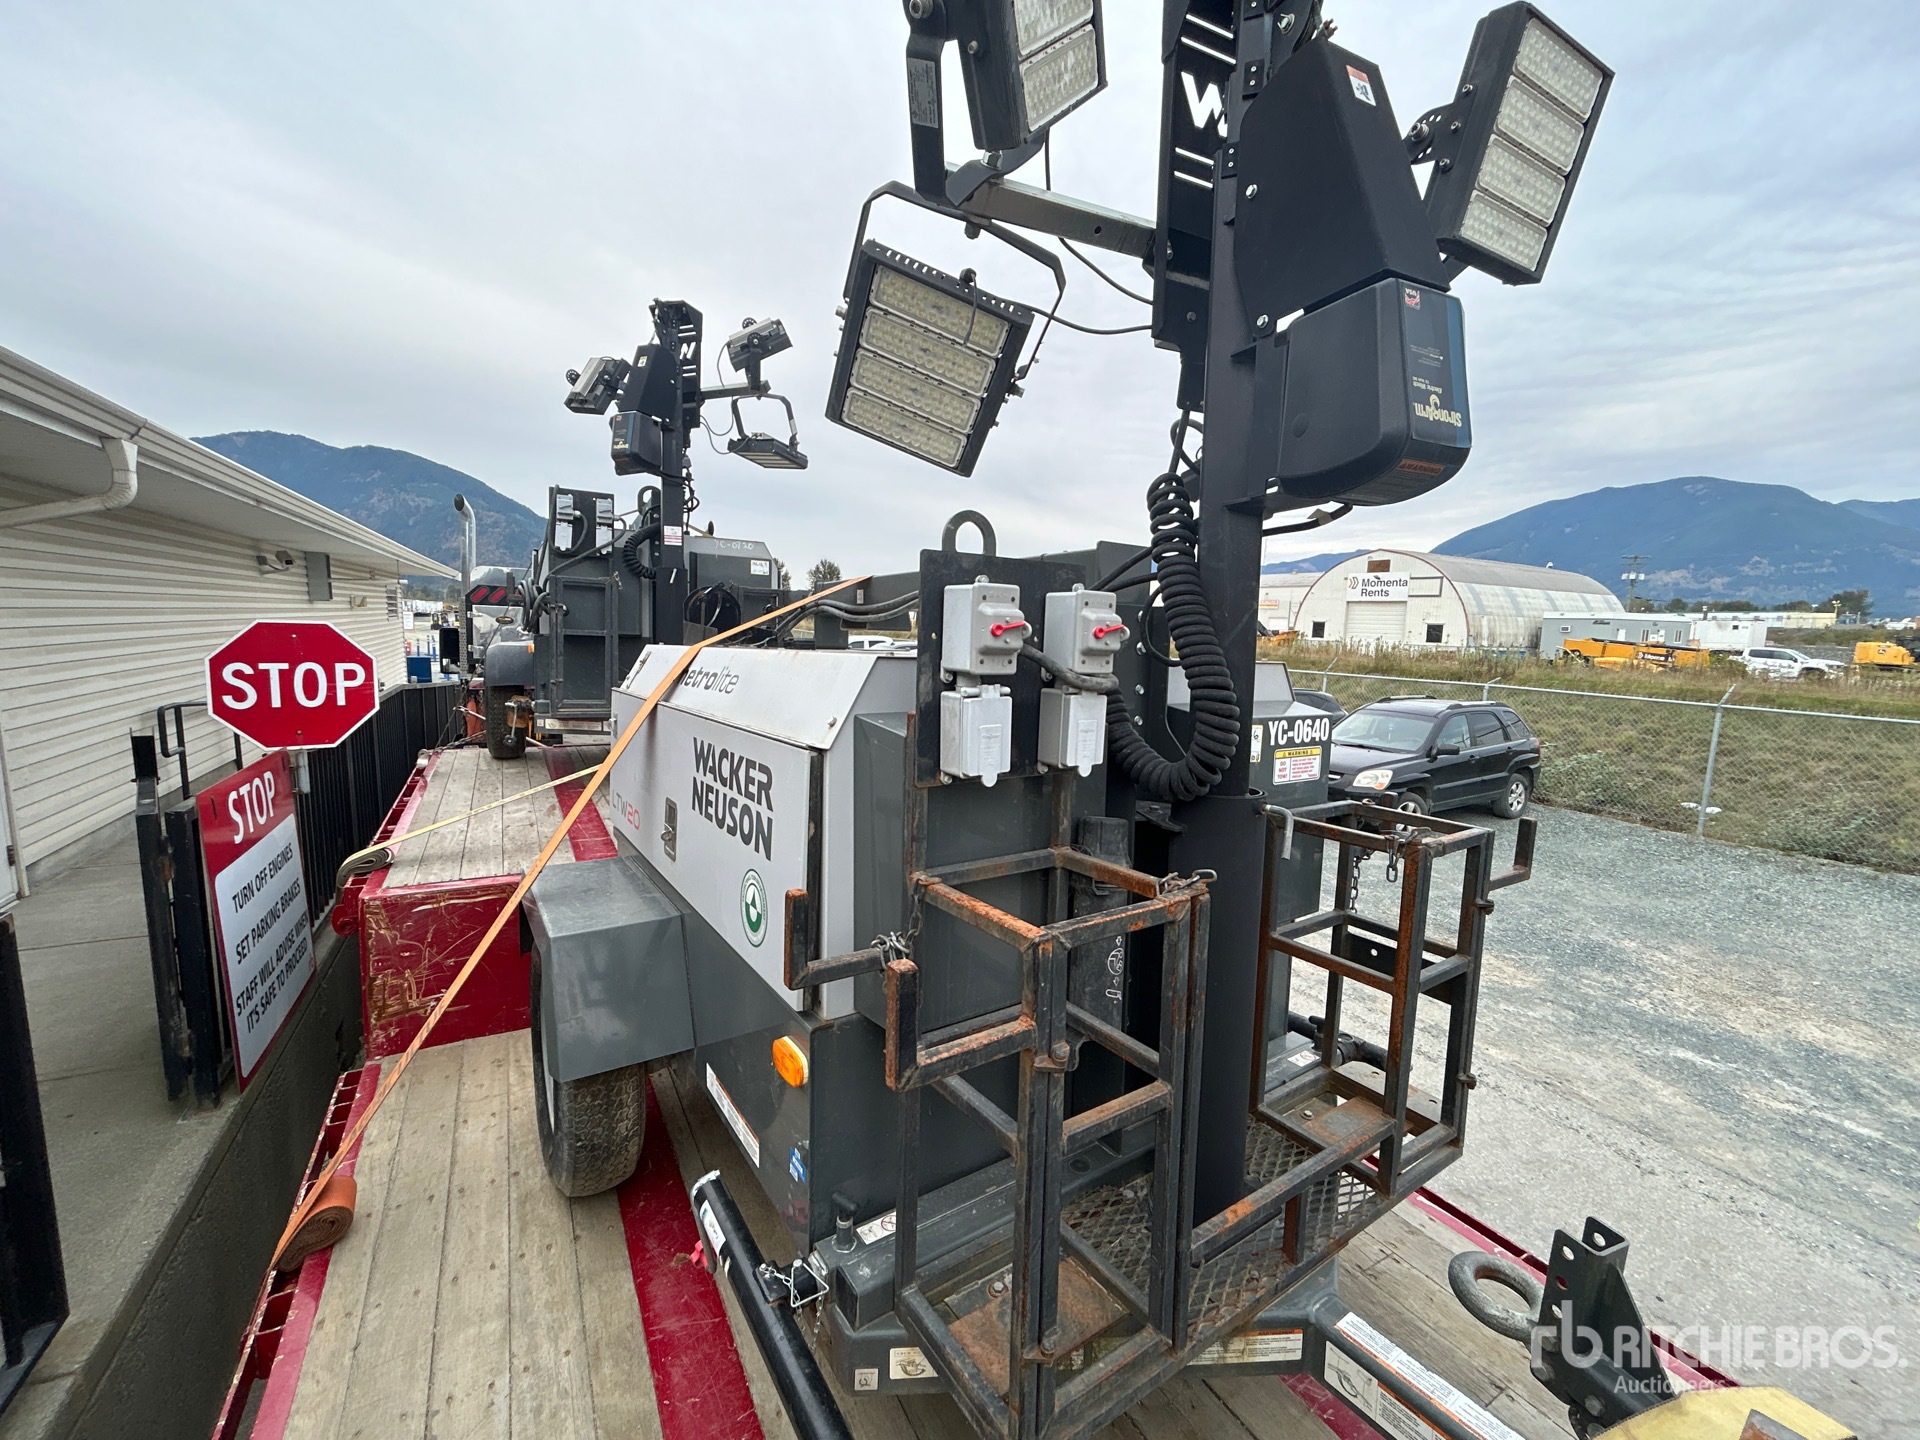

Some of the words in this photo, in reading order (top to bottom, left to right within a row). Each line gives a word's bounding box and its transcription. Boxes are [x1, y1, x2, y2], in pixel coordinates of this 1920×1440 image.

[1361, 577, 1408, 588] Momenta
[1361, 588, 1390, 597] Rents
[222, 662, 366, 710] STOP
[1268, 718, 1330, 746] YC-0640
[228, 771, 275, 844] STOP
[612, 789, 640, 831] LTW20
[693, 737, 773, 812] WACKER
[692, 776, 773, 861] NEUSON
[232, 880, 255, 913] TURN
[254, 867, 268, 892] OFF
[268, 843, 293, 880] ENGINES
[235, 933, 251, 965] SET
[251, 901, 281, 948] PARKING
[280, 877, 301, 916] BRAKES
[236, 975, 258, 1016] STAFF
[258, 956, 275, 986] WILL
[275, 928, 295, 968] ADVISE
[294, 909, 309, 938] WHEN
[260, 979, 277, 1016] SAFE
[276, 968, 285, 992] TO
[285, 936, 308, 980] PROCEED
